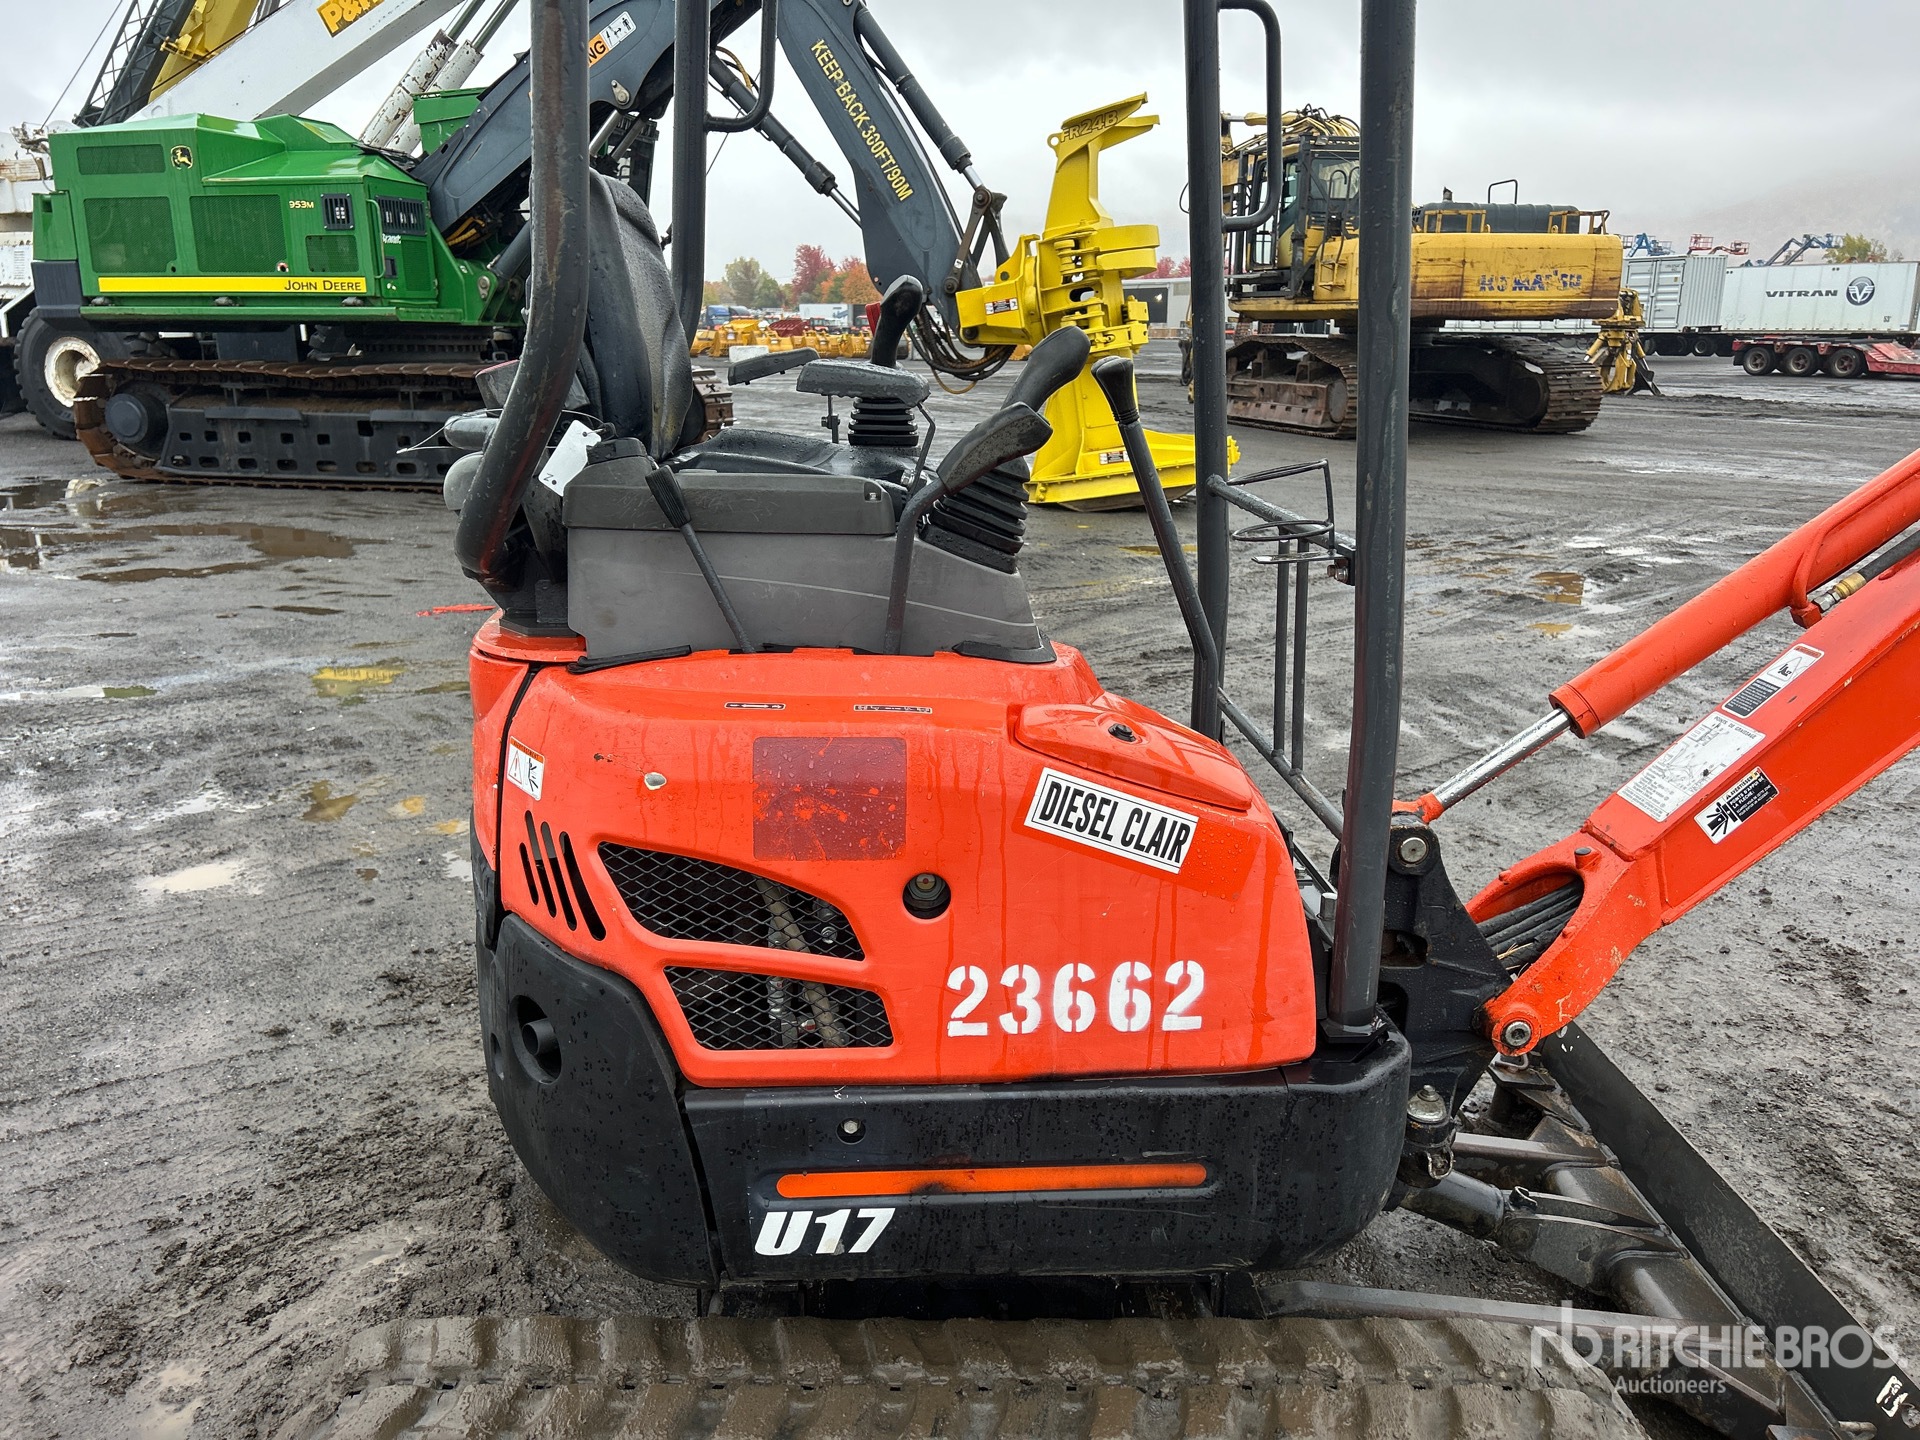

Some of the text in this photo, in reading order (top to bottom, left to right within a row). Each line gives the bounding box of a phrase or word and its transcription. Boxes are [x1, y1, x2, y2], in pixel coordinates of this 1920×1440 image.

[810, 38, 914, 202] KEEP BACK 300FT/90M
[1060, 110, 1119, 143] FR24B
[289, 201, 314, 209] 953M
[284, 280, 362, 292] JOHN DEERE
[1765, 289, 1838, 298] VITRAN
[1730, 768, 1761, 795] AVERTISSEMNT
[1039, 781, 1191, 864] DIESEL CLAIR
[947, 960, 1205, 1037] 23662
[754, 1207, 895, 1256] U17
